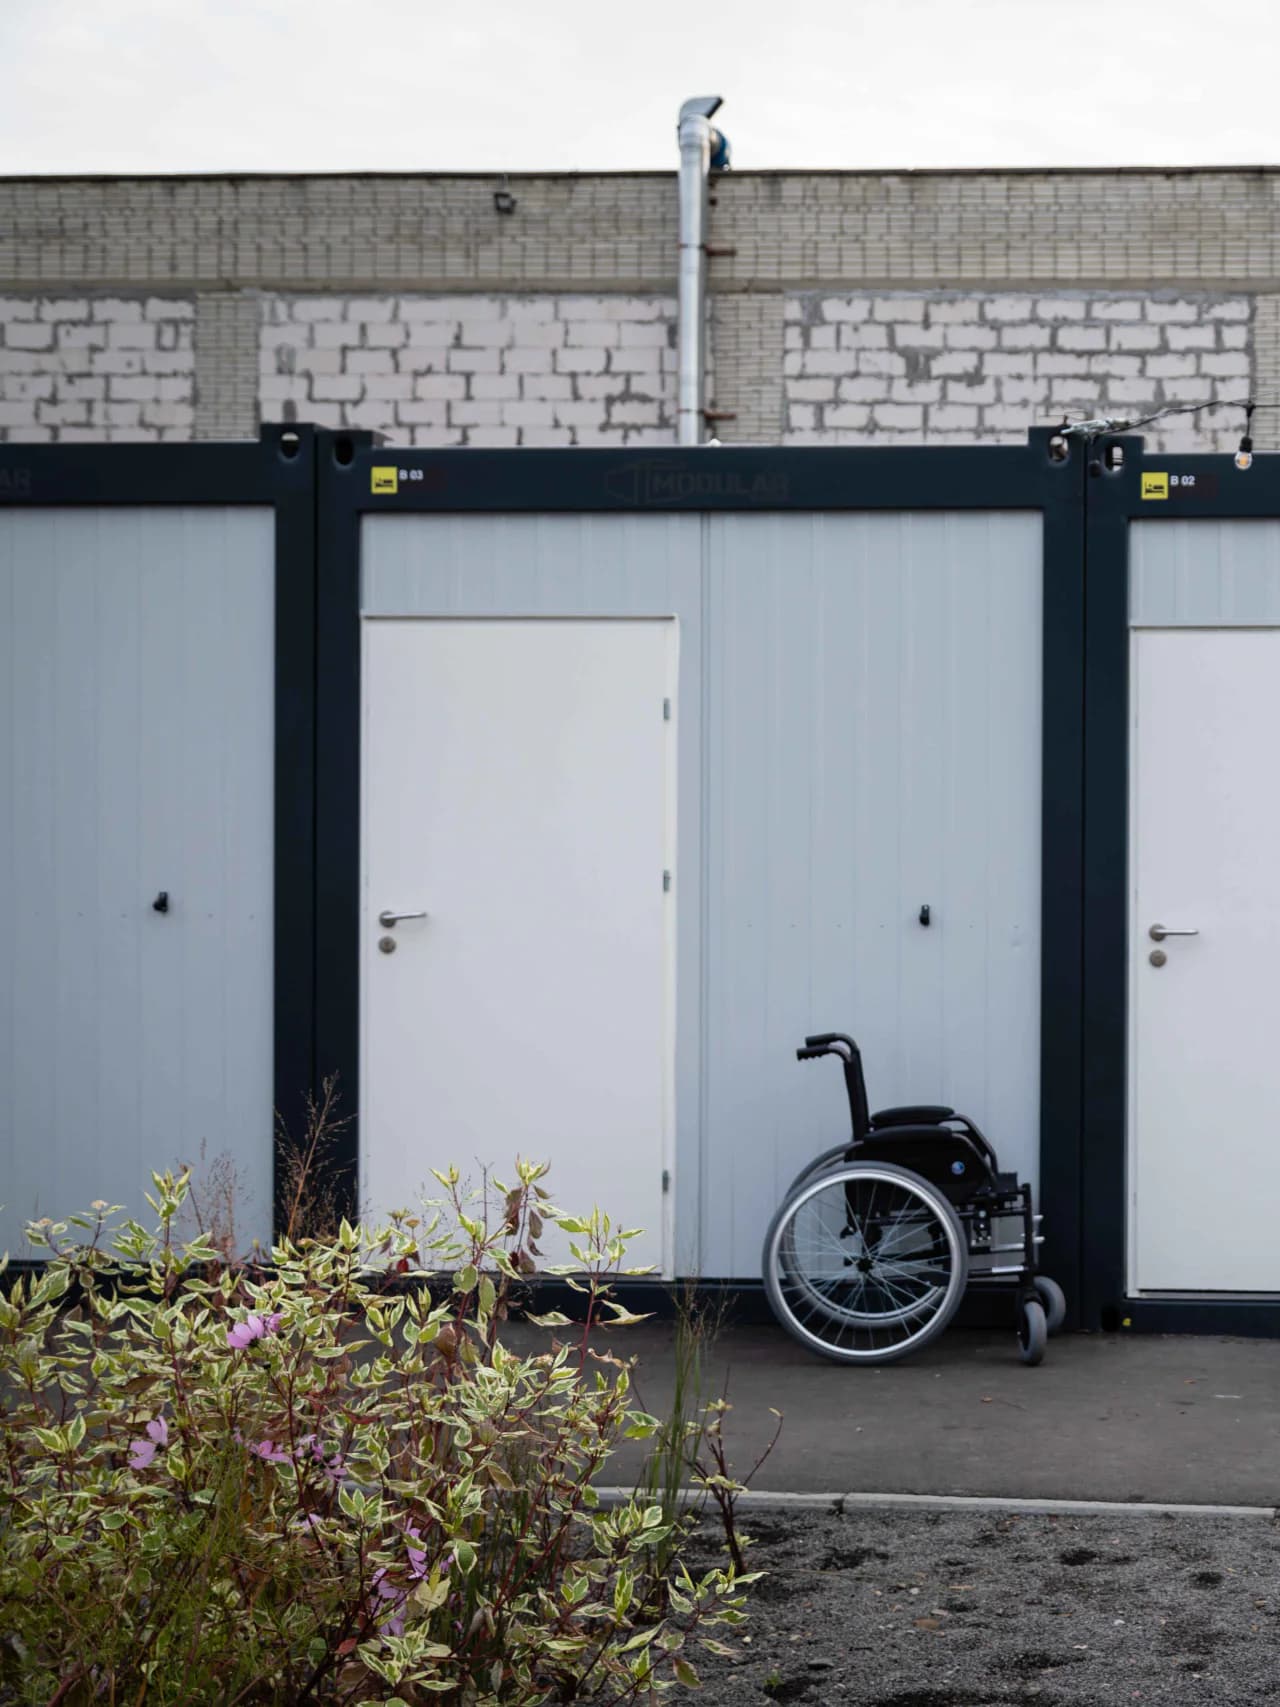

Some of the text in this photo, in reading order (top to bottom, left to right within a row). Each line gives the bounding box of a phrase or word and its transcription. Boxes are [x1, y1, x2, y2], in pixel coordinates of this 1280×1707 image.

[399, 469, 424, 481] B 03
[1170, 475, 1195, 486] B 02
